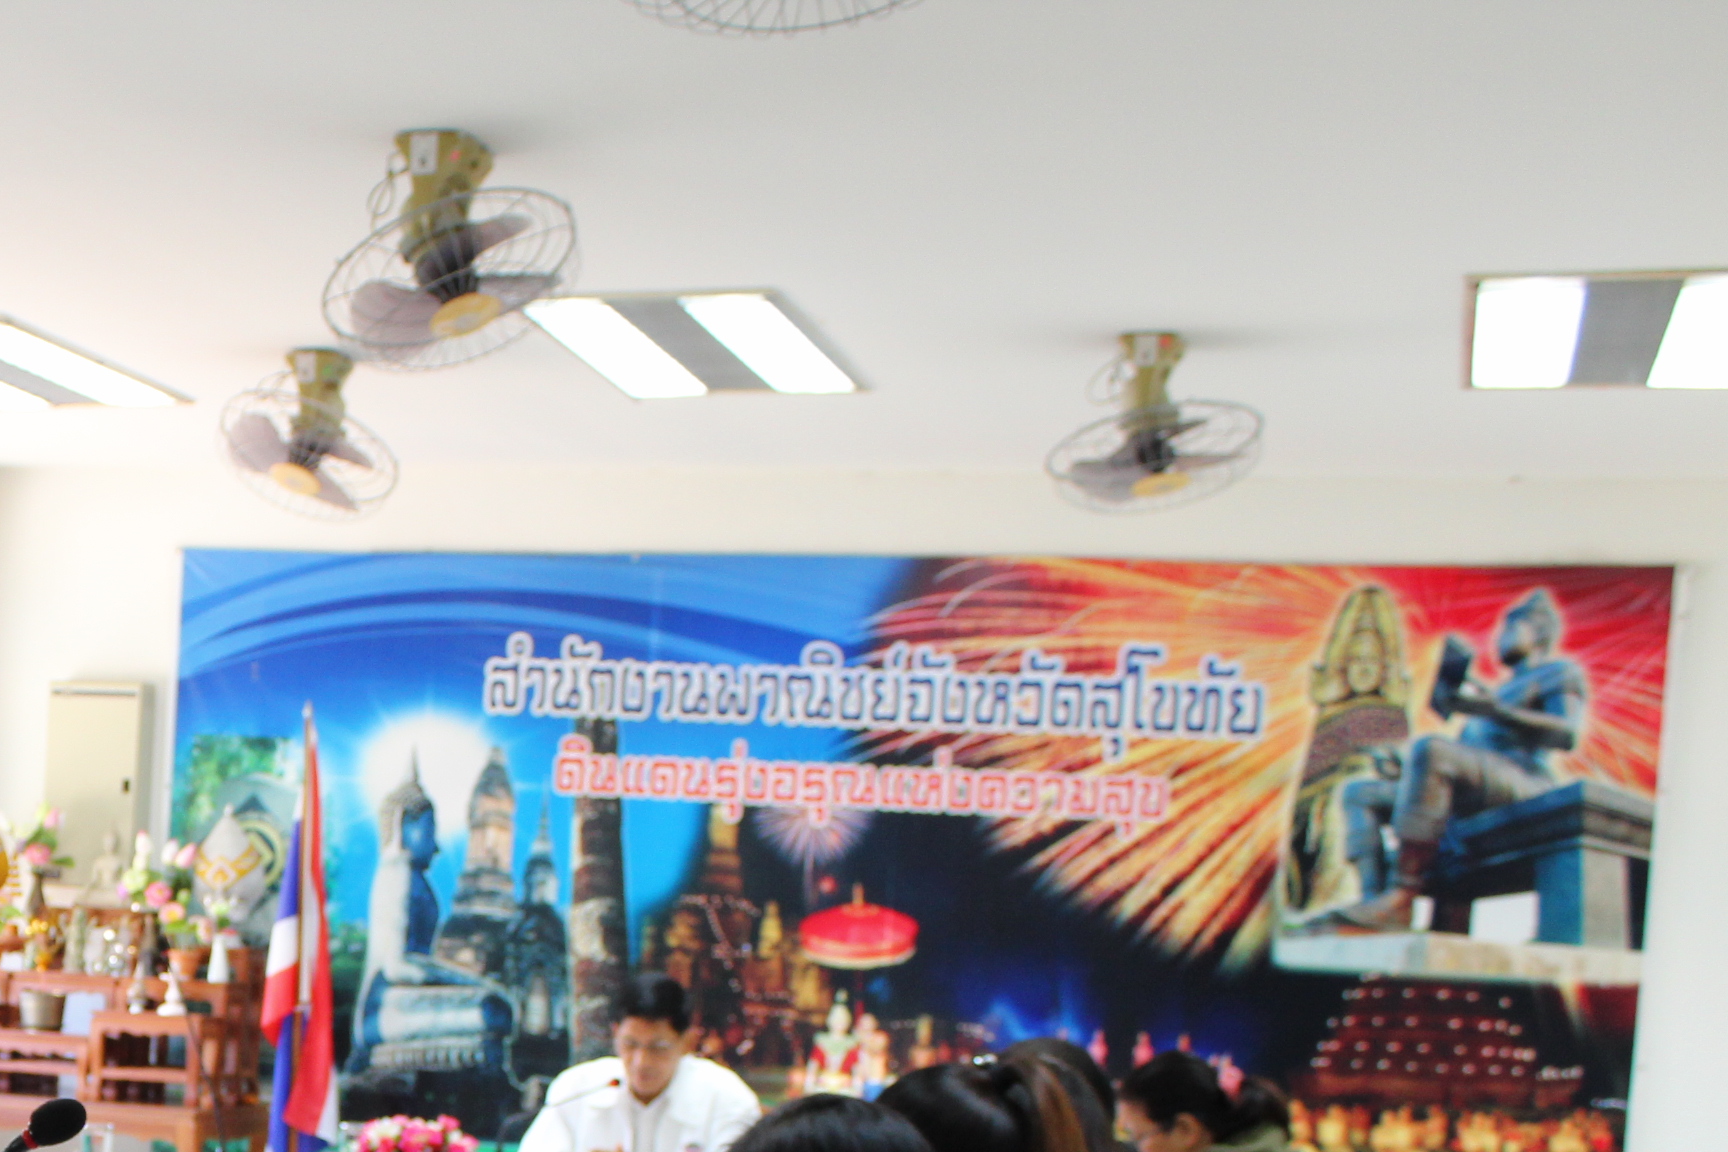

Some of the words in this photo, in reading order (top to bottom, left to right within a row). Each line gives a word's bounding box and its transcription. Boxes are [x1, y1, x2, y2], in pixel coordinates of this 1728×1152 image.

[483, 631, 1266, 762] สำนักงานพาณิชย์จังหวัดสุโขทัย
[553, 732, 1171, 840] ดินแดนรุ่งอรุณแห่งความสุข
